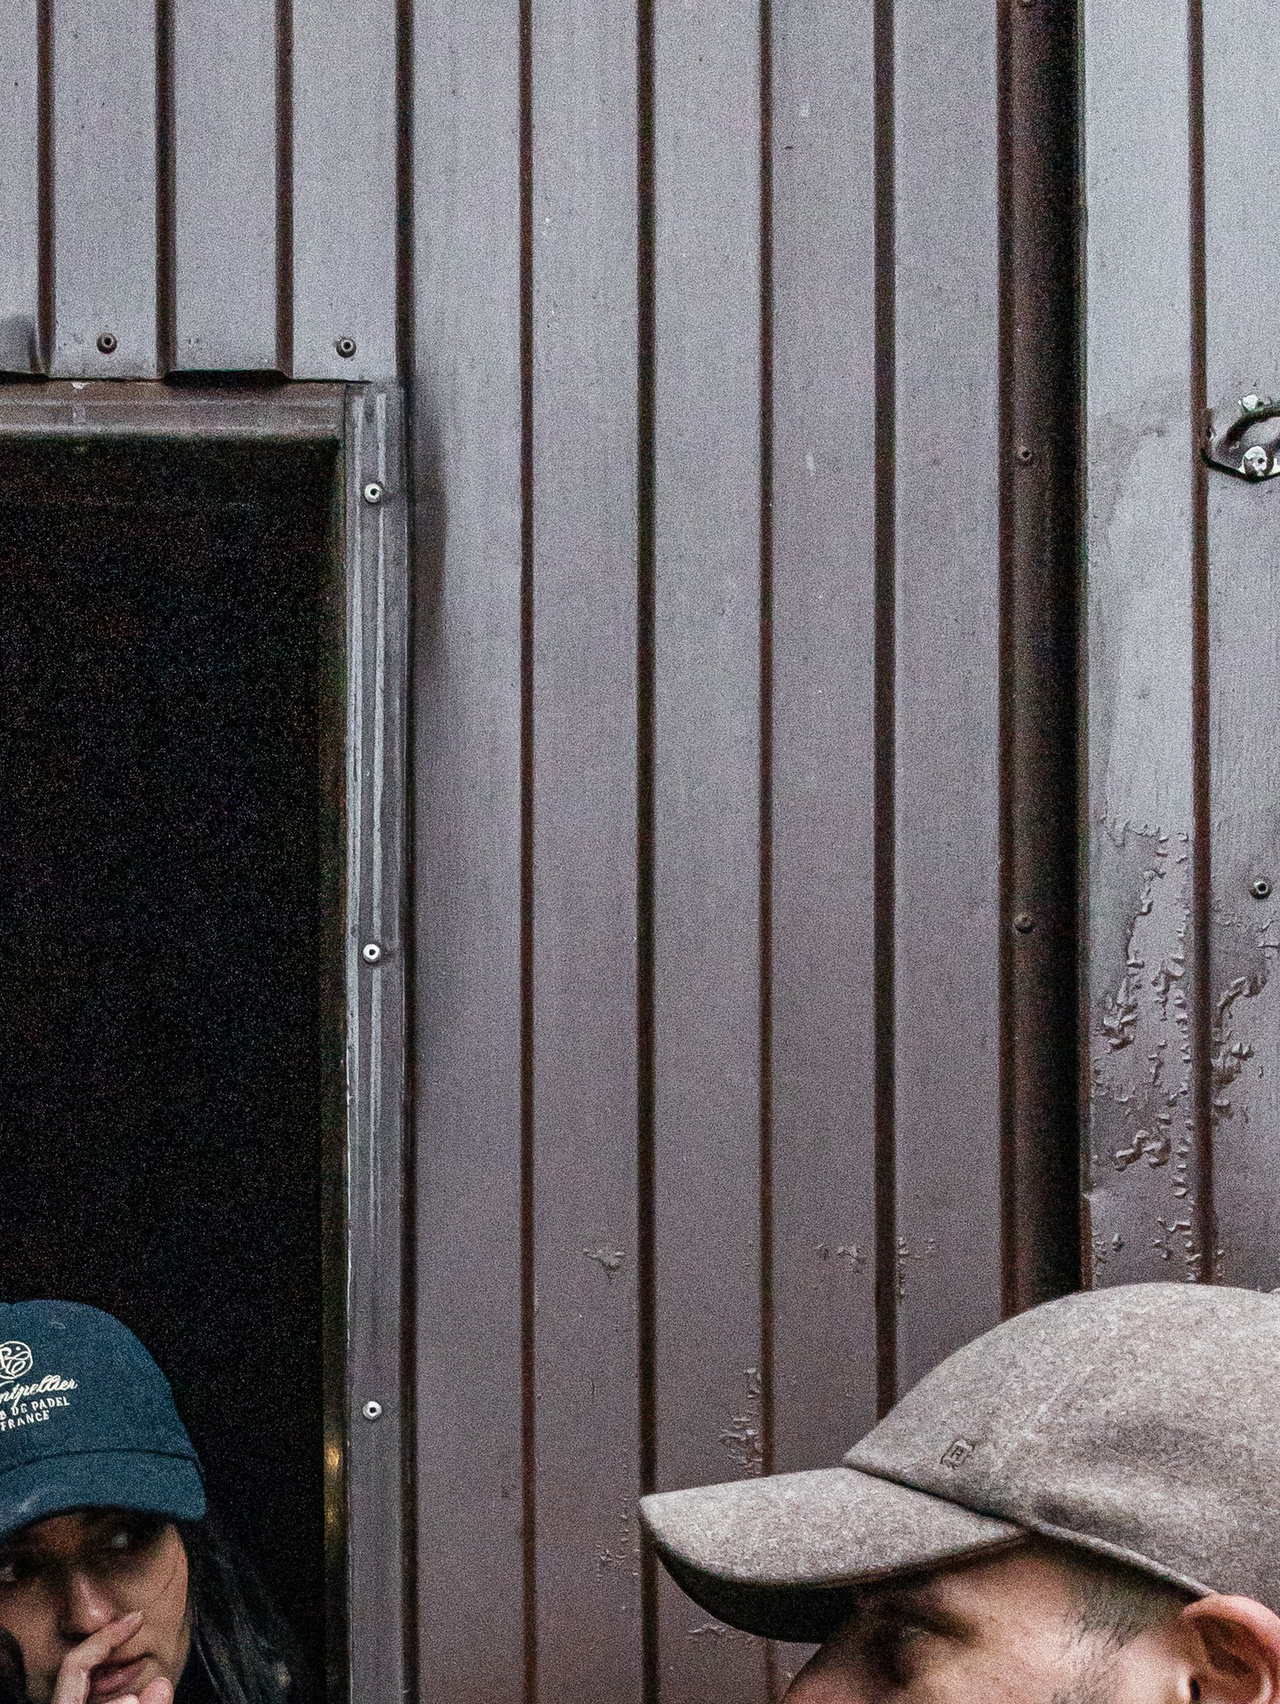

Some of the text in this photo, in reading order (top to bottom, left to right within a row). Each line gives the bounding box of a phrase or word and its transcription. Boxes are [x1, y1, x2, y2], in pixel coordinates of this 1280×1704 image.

[11, 1404, 27, 1416] DE
[31, 1396, 70, 1411] PADEL
[0, 1410, 50, 1432] FRANCE
